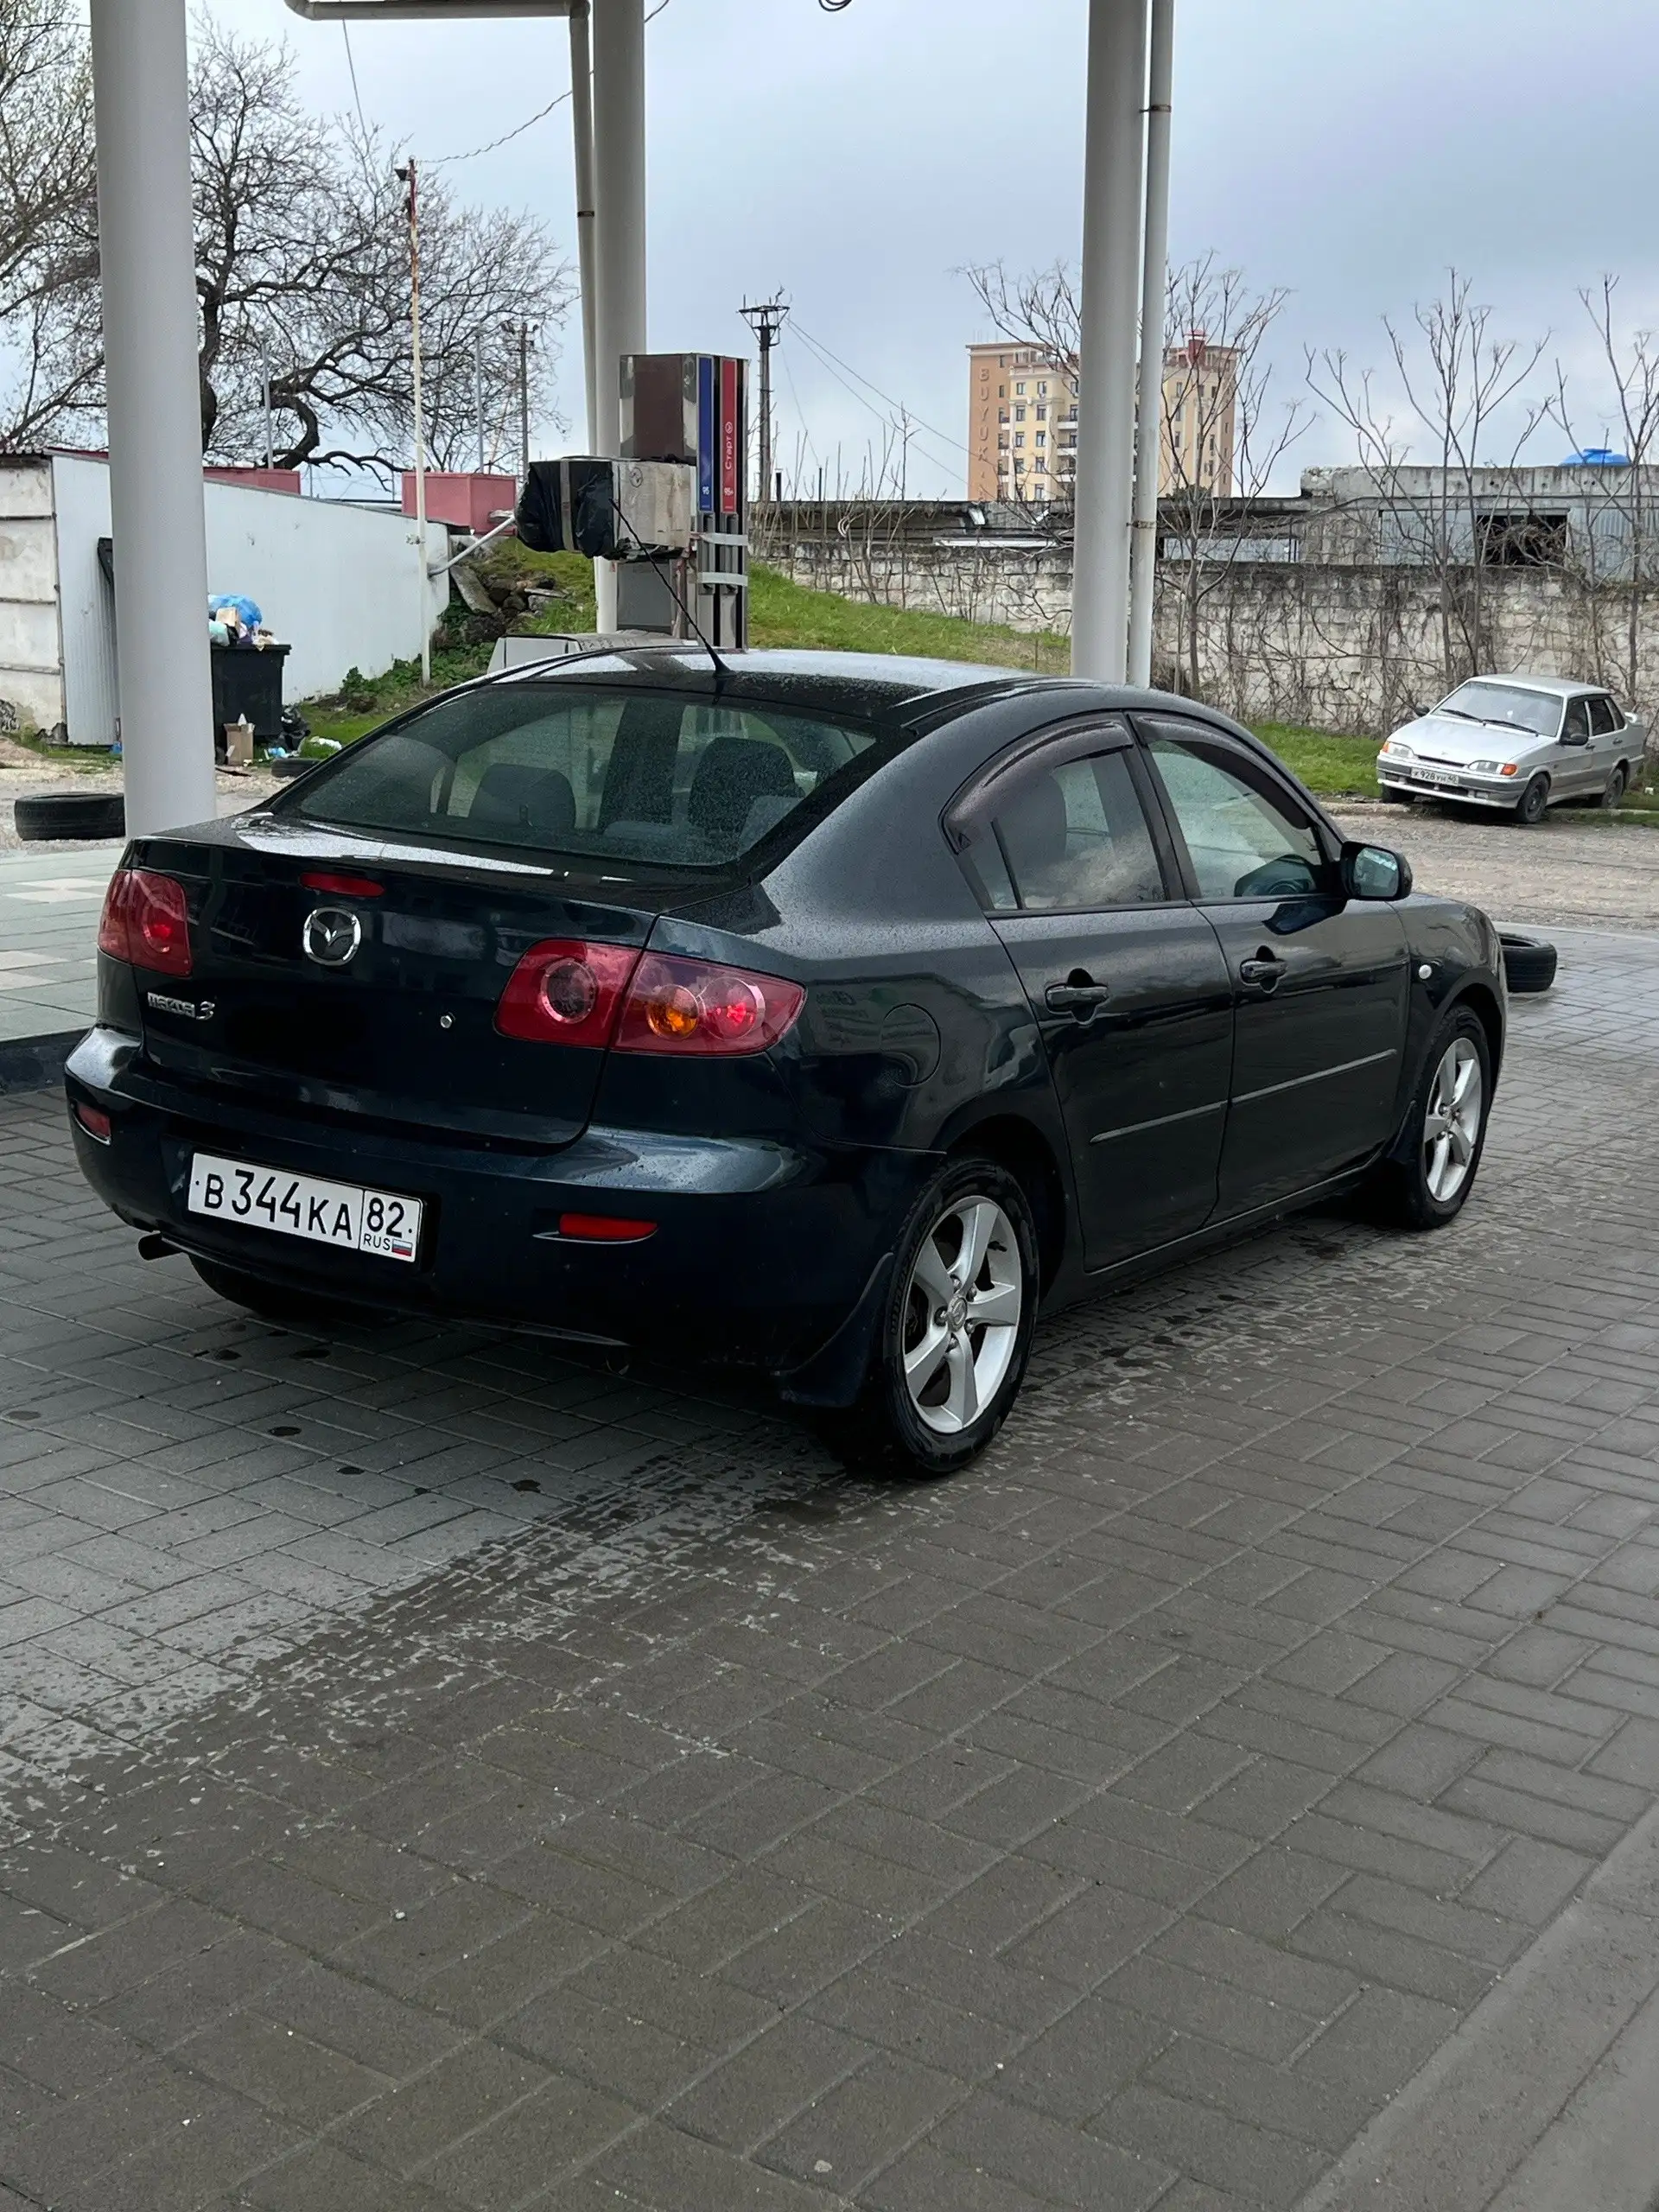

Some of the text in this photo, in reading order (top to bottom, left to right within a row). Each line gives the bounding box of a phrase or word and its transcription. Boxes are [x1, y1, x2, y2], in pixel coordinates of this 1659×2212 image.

[204, 1169, 405, 1241] В344КА 82
[363, 1234, 391, 1251] RUS
